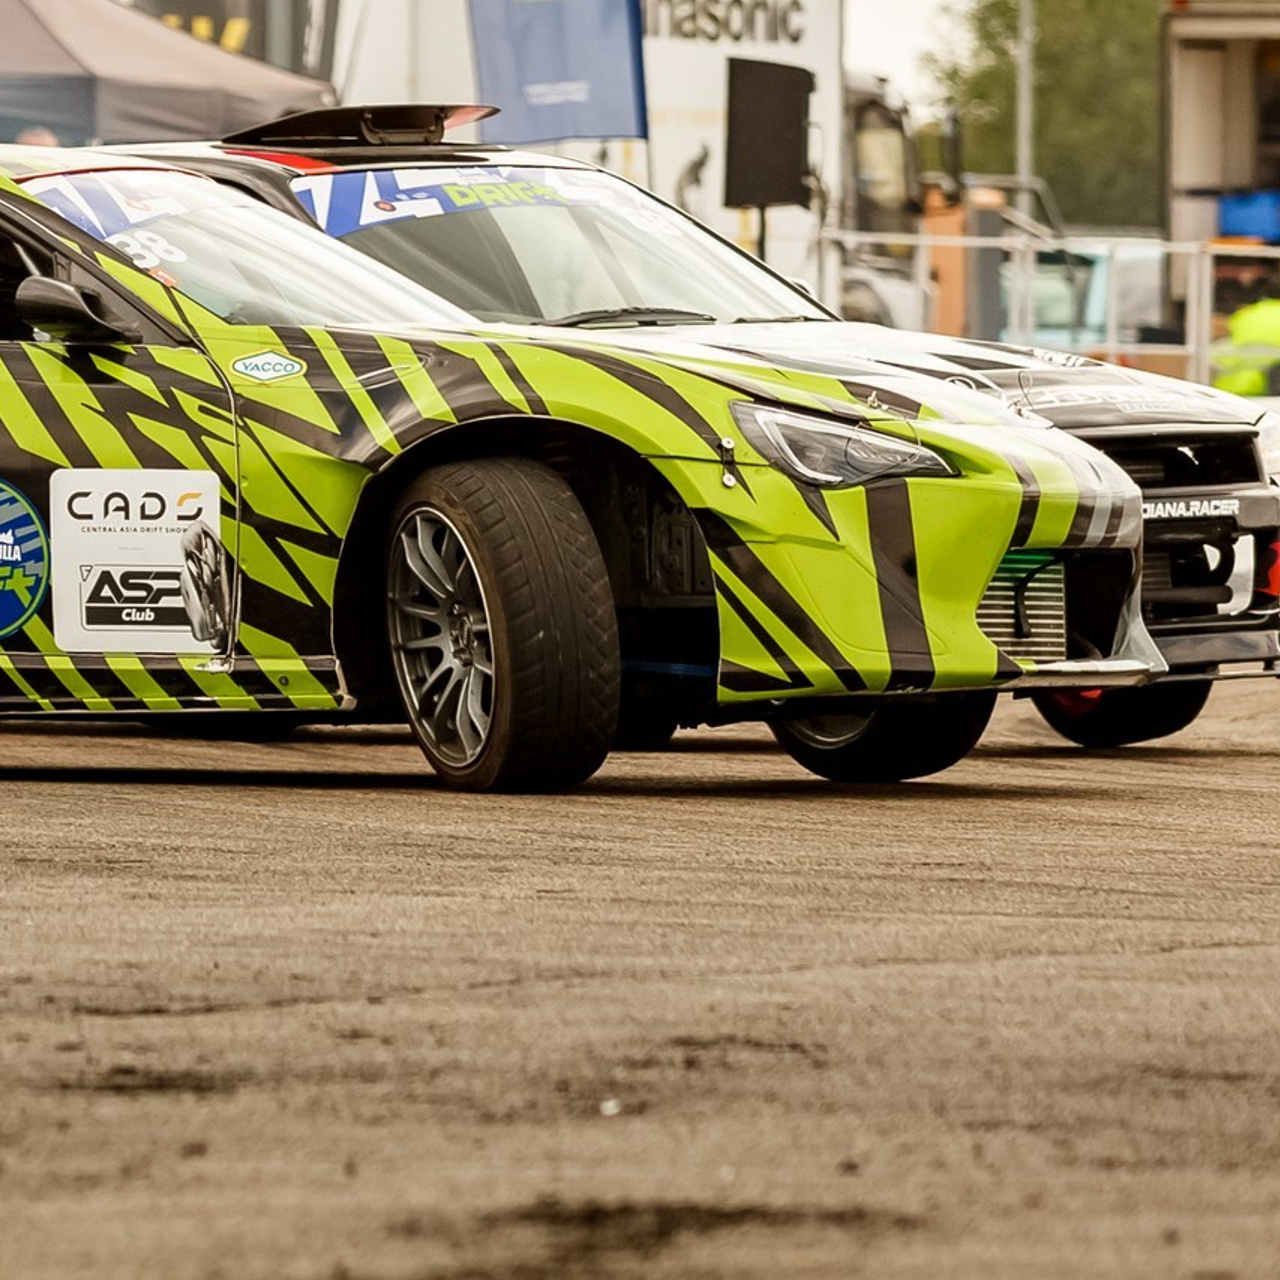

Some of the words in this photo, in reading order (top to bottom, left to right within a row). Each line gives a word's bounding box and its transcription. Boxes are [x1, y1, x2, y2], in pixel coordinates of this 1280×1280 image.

[104, 230, 188, 269] 38
[242, 362, 295, 373] YACCO
[67, 491, 203, 521] CADS
[121, 608, 155, 622] Club
